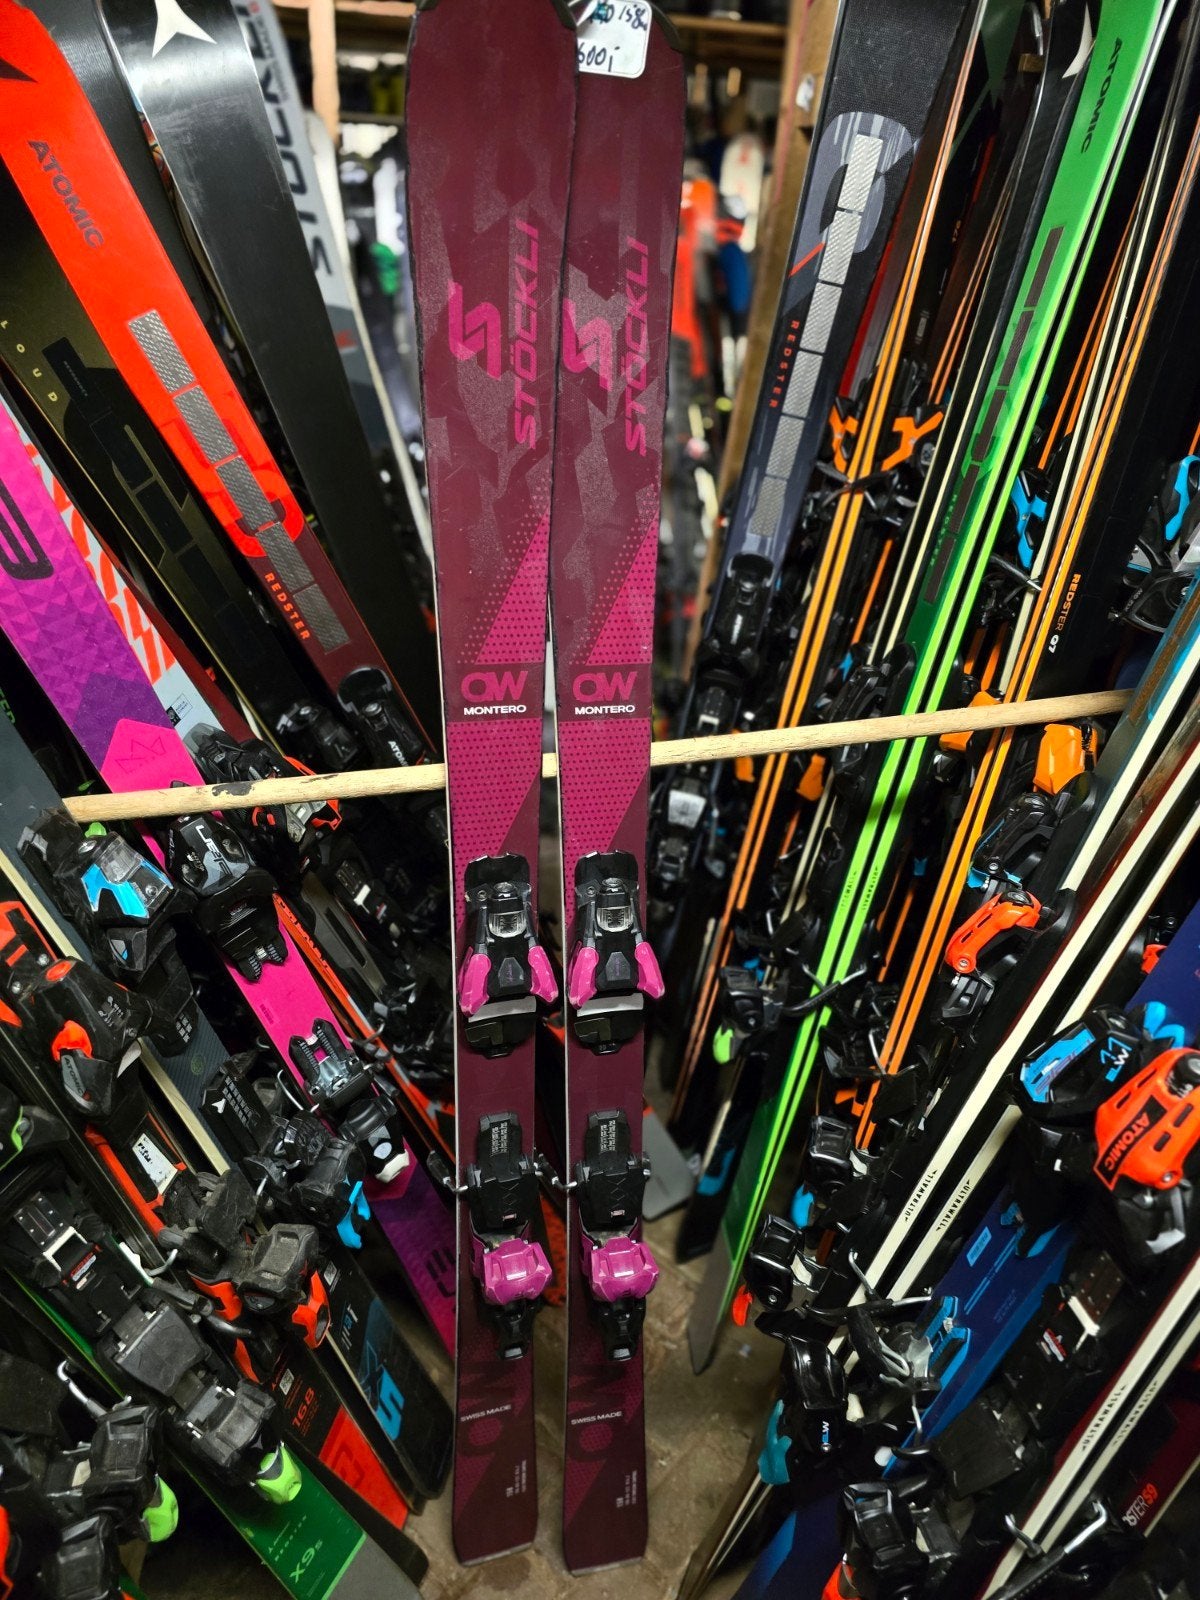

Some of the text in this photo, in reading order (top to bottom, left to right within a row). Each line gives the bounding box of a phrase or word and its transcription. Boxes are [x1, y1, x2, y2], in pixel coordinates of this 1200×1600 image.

[1081, 37, 1123, 154] ATOMIC
[27, 140, 104, 249] ATOMIC
[510, 218, 539, 450] STÖCKLI
[620, 235, 649, 457] STÖCKLI
[769, 320, 800, 408] REDSTER
[264, 572, 310, 640] REDSTER
[1055, 573, 1081, 631] REDSTER
[463, 704, 527, 716] MONTERO
[574, 704, 636, 715] MONTERO
[388, 741, 409, 767] ATOM
[64, 1057, 84, 1095] ATOMIC
[1104, 1112, 1150, 1171] ATOMIC
[904, 1174, 934, 1217] ULTRAWALL
[939, 1184, 971, 1227] ULTRAWALL
[292, 1387, 316, 1428] 168
[460, 1404, 512, 1422] SWISS MADE
[570, 1410, 623, 1426] SWISS MADE
[1082, 1391, 1121, 1444] ULTRAWALL
